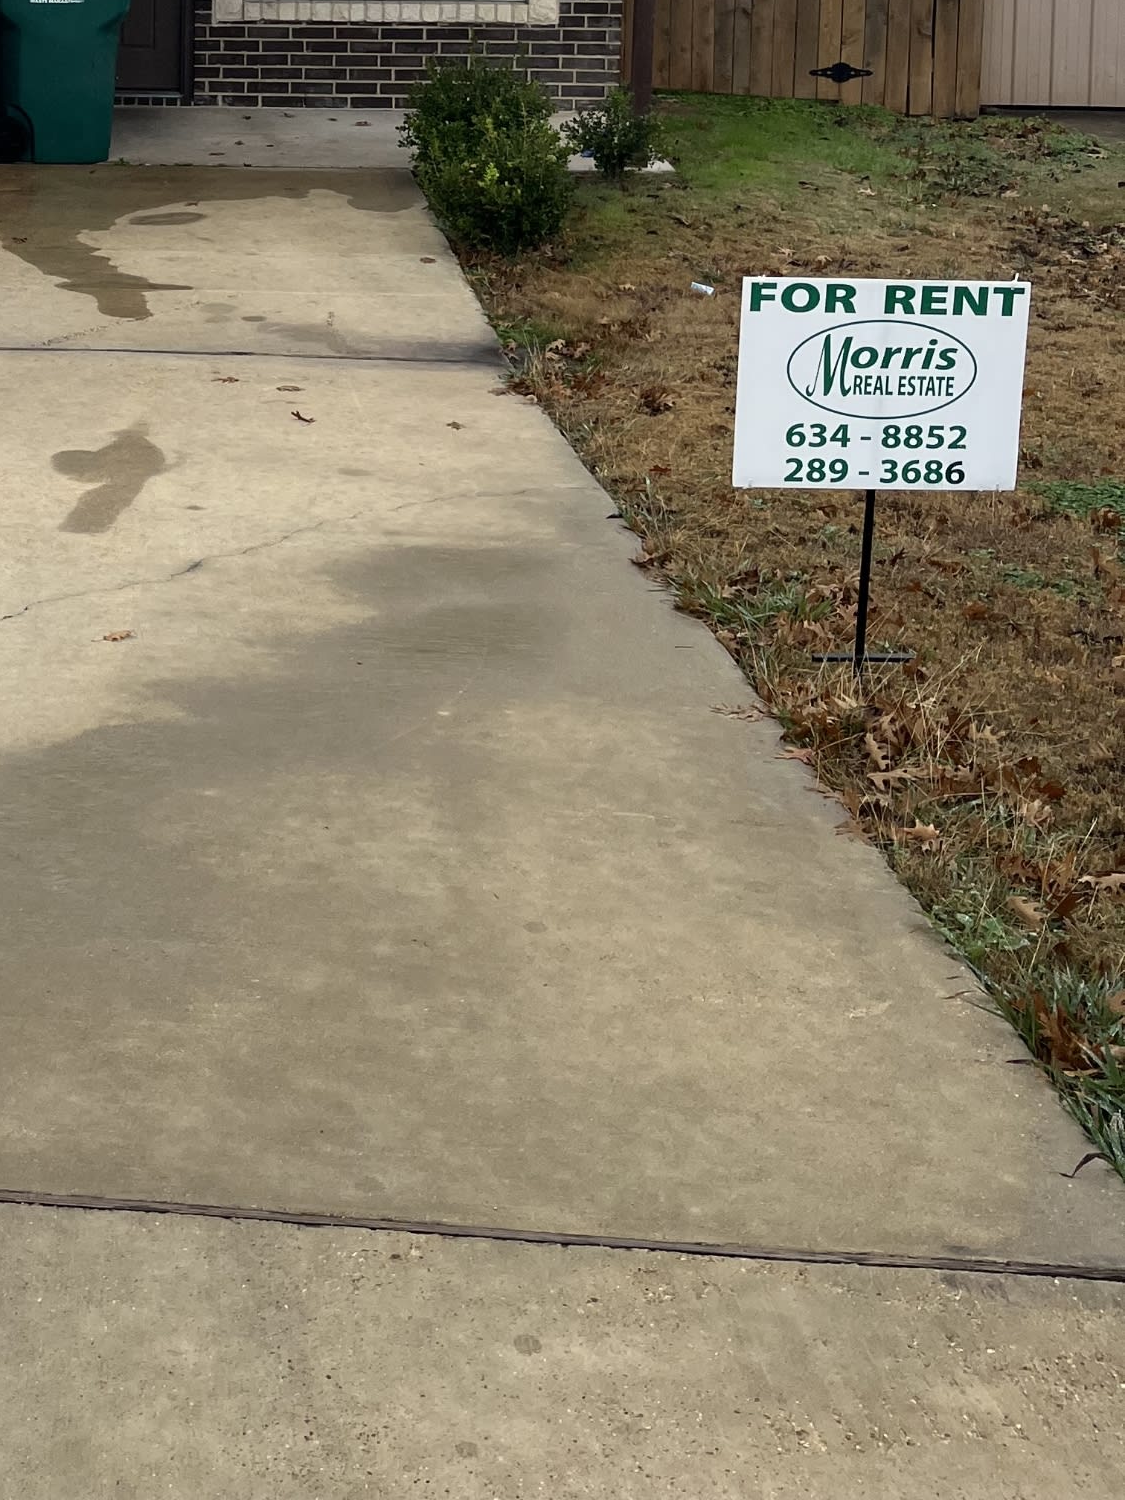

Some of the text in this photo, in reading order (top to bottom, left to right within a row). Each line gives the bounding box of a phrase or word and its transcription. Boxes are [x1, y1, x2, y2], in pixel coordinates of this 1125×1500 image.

[749, 282, 1025, 317] FOR RENT
[805, 333, 959, 397] Morris
[852, 374, 955, 397] REAL ESTATE
[785, 423, 851, 448] 634
[881, 424, 967, 449] 8852
[783, 457, 849, 483] 289
[879, 459, 966, 485] 3686
